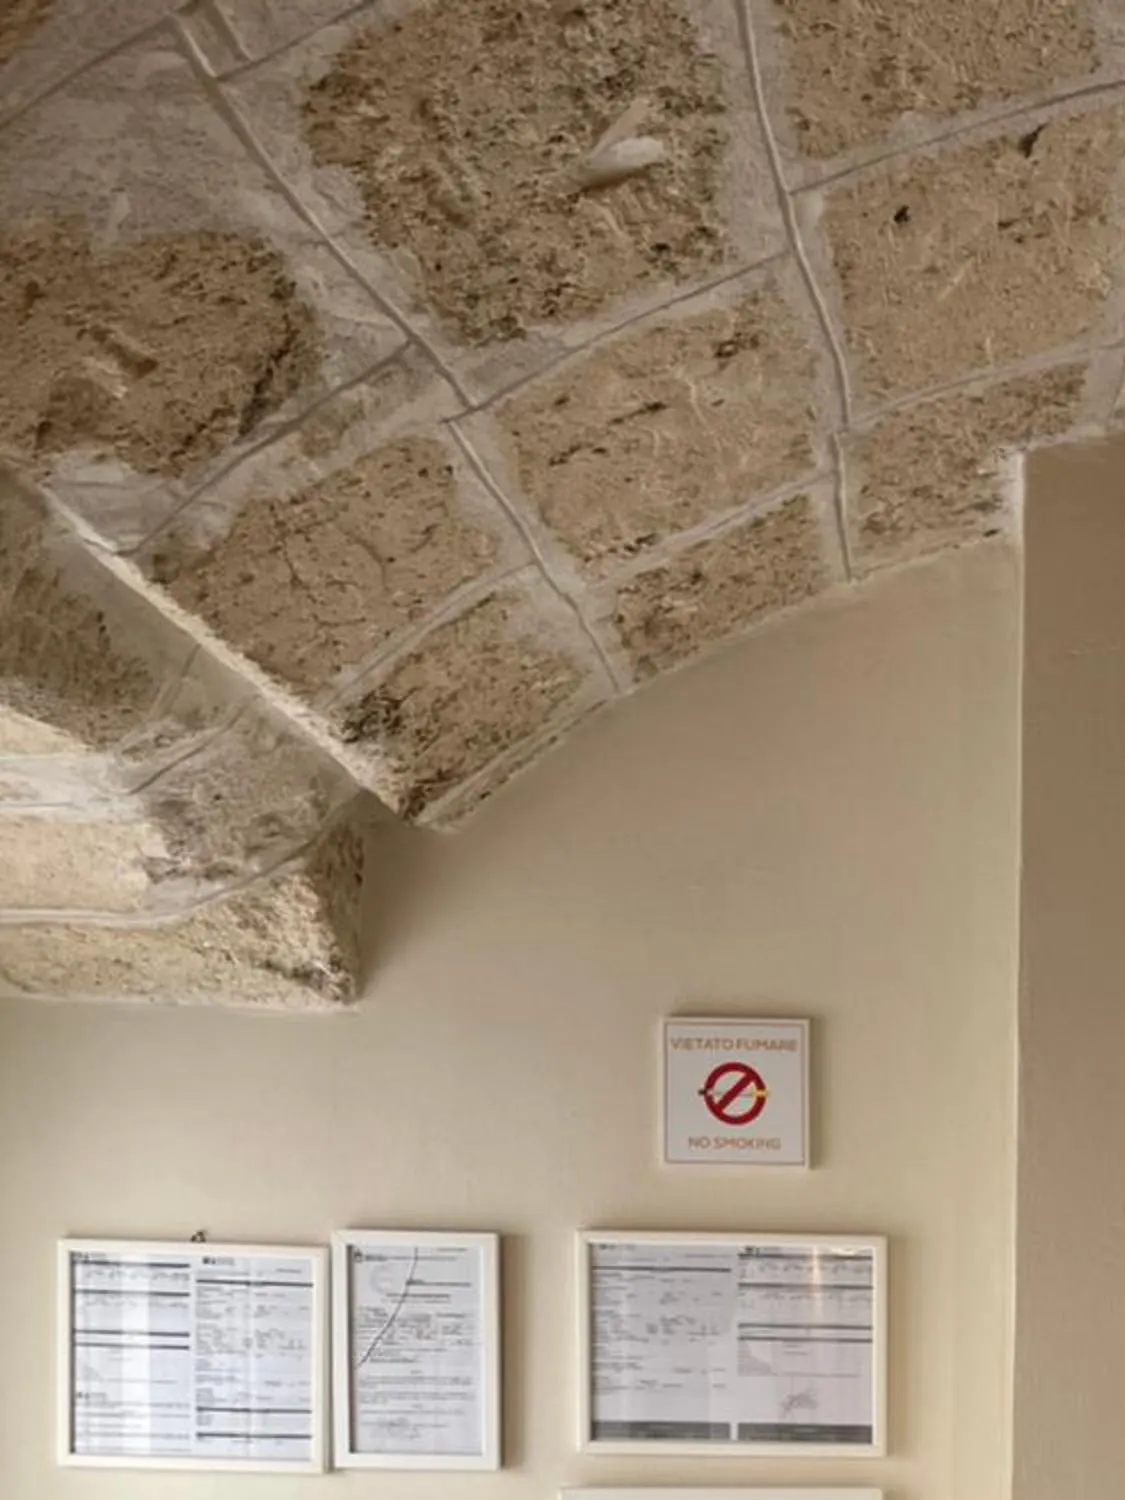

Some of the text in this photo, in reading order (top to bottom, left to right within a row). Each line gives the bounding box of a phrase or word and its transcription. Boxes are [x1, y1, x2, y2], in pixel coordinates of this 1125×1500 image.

[670, 1037, 797, 1052] VIETATO FUMARE
[688, 1136, 781, 1150] NO SMOKING
